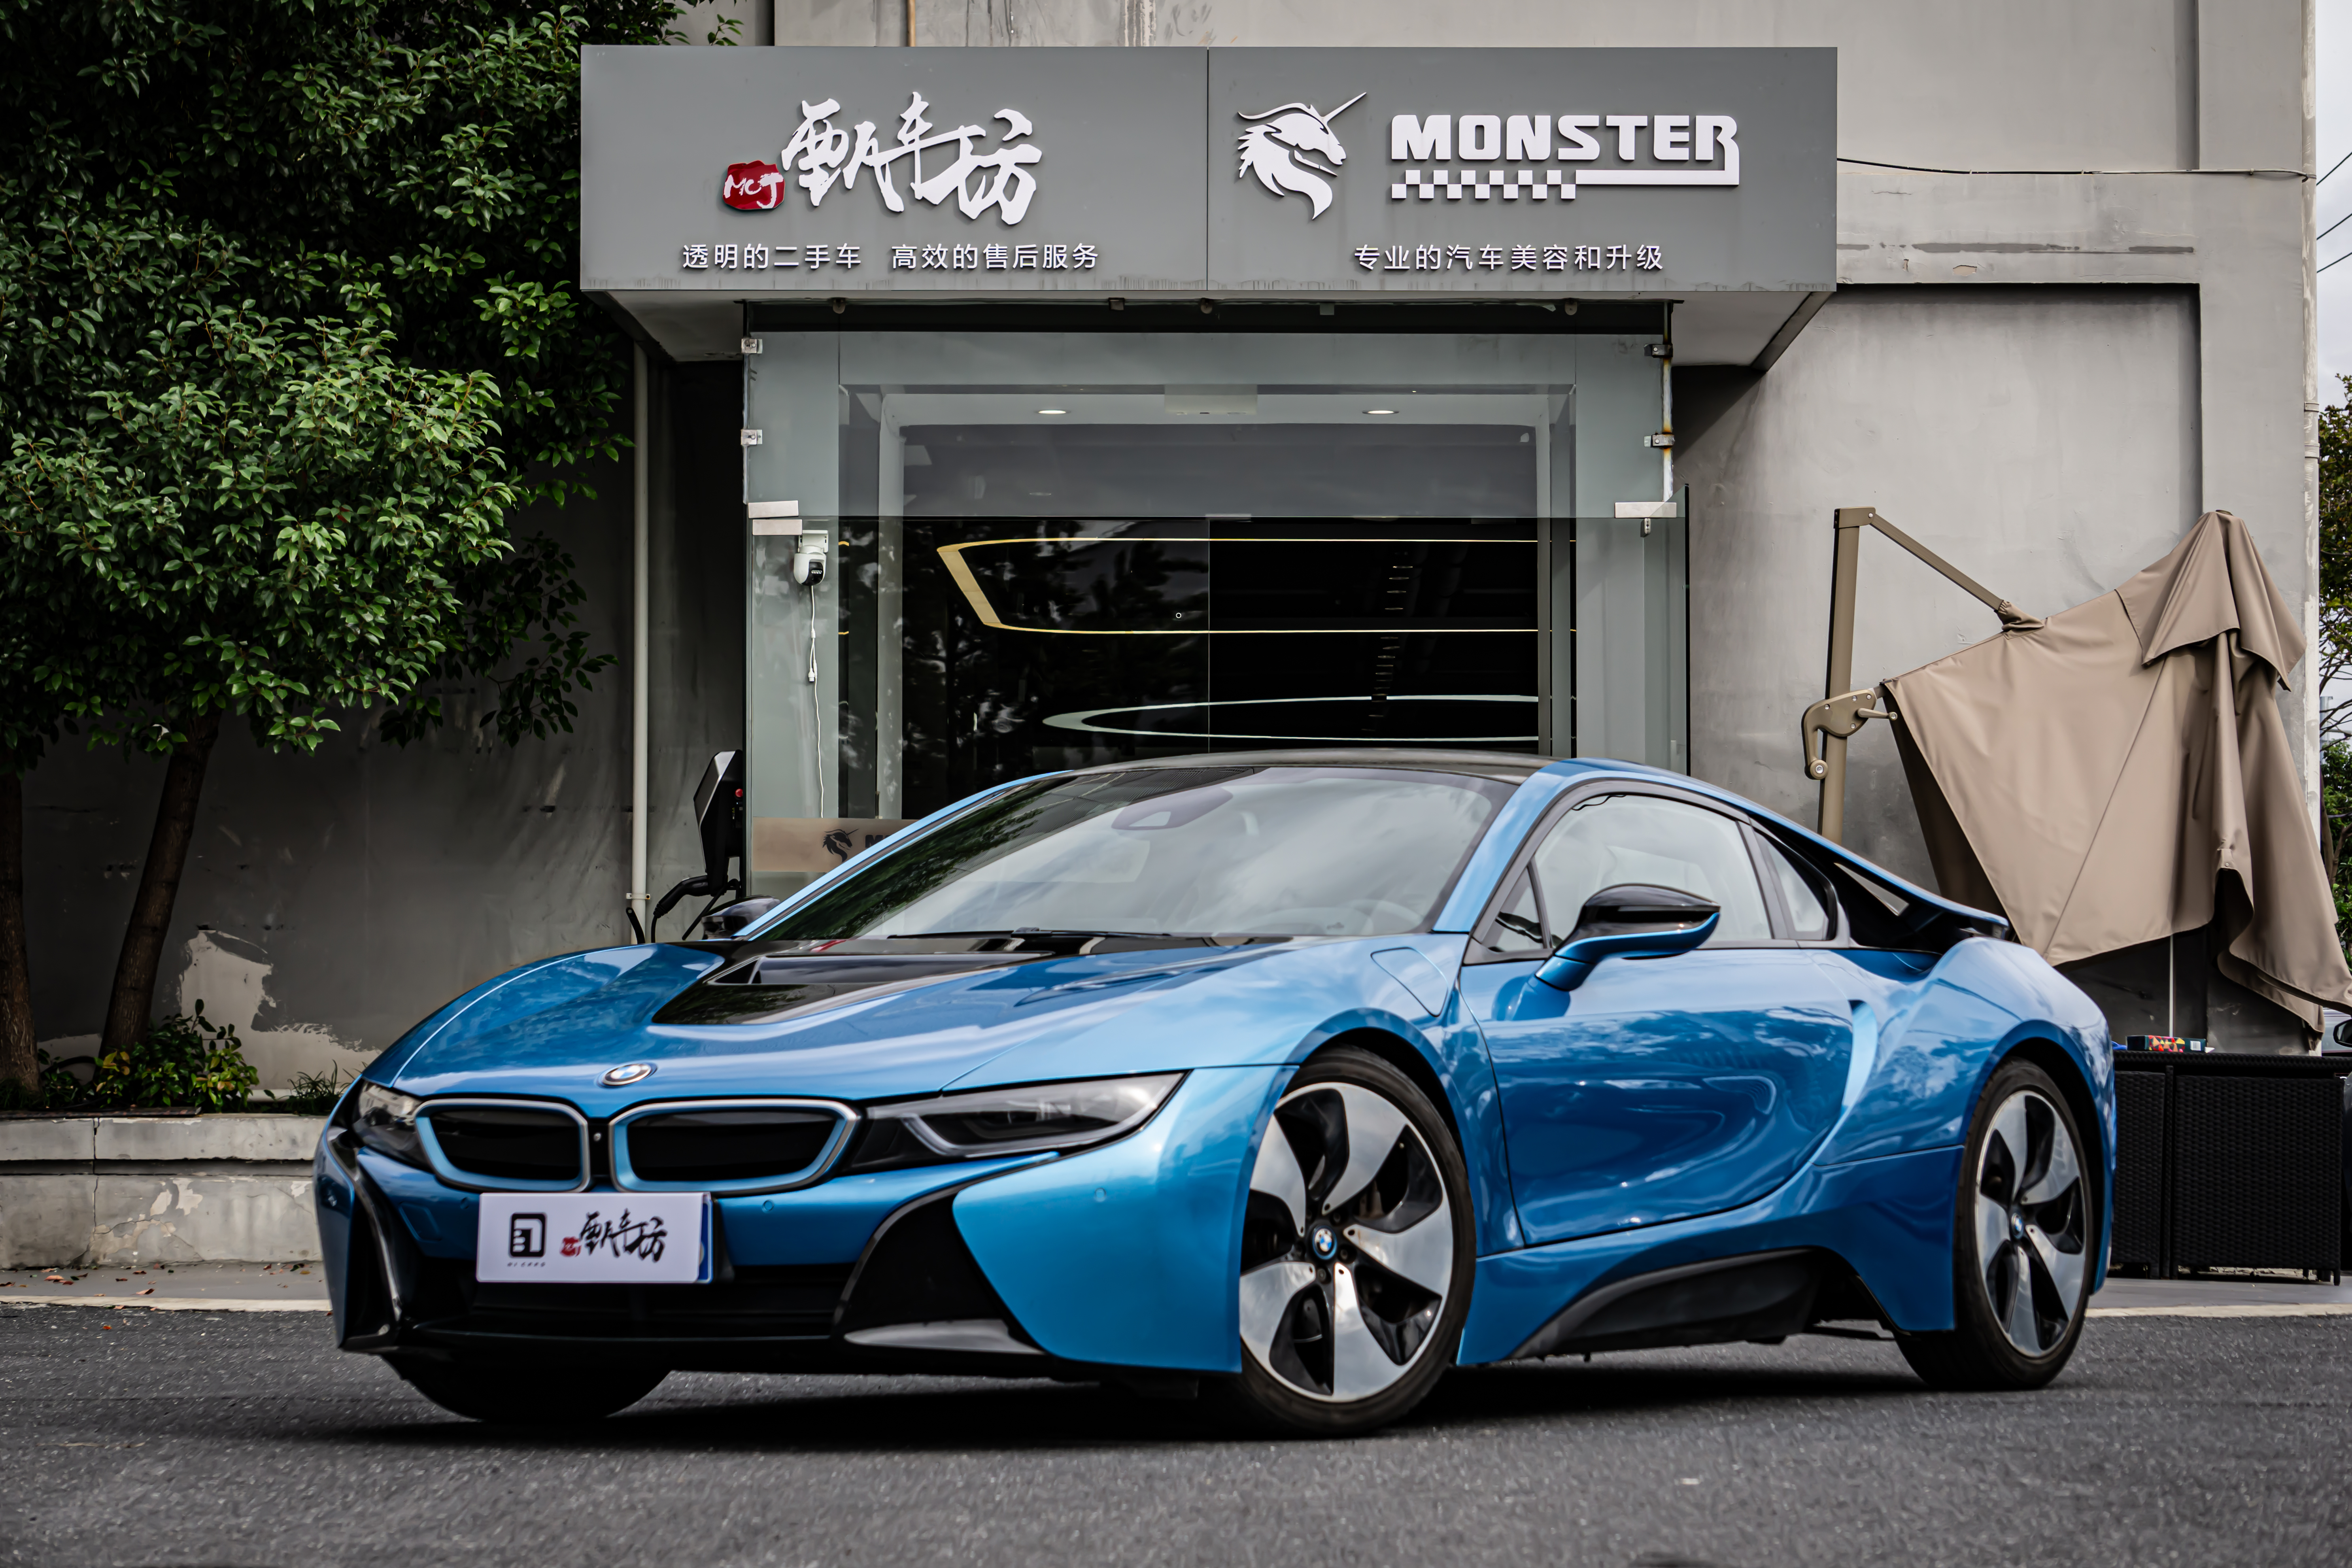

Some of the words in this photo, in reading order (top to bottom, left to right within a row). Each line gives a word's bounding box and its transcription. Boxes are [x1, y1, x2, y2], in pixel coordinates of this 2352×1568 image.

[1392, 115, 1739, 185] MONSTER
[682, 243, 861, 269] 透明的二手车
[891, 243, 1098, 269] 高效的售后服务
[1354, 244, 1663, 270] 专业的汽车美容和升级
